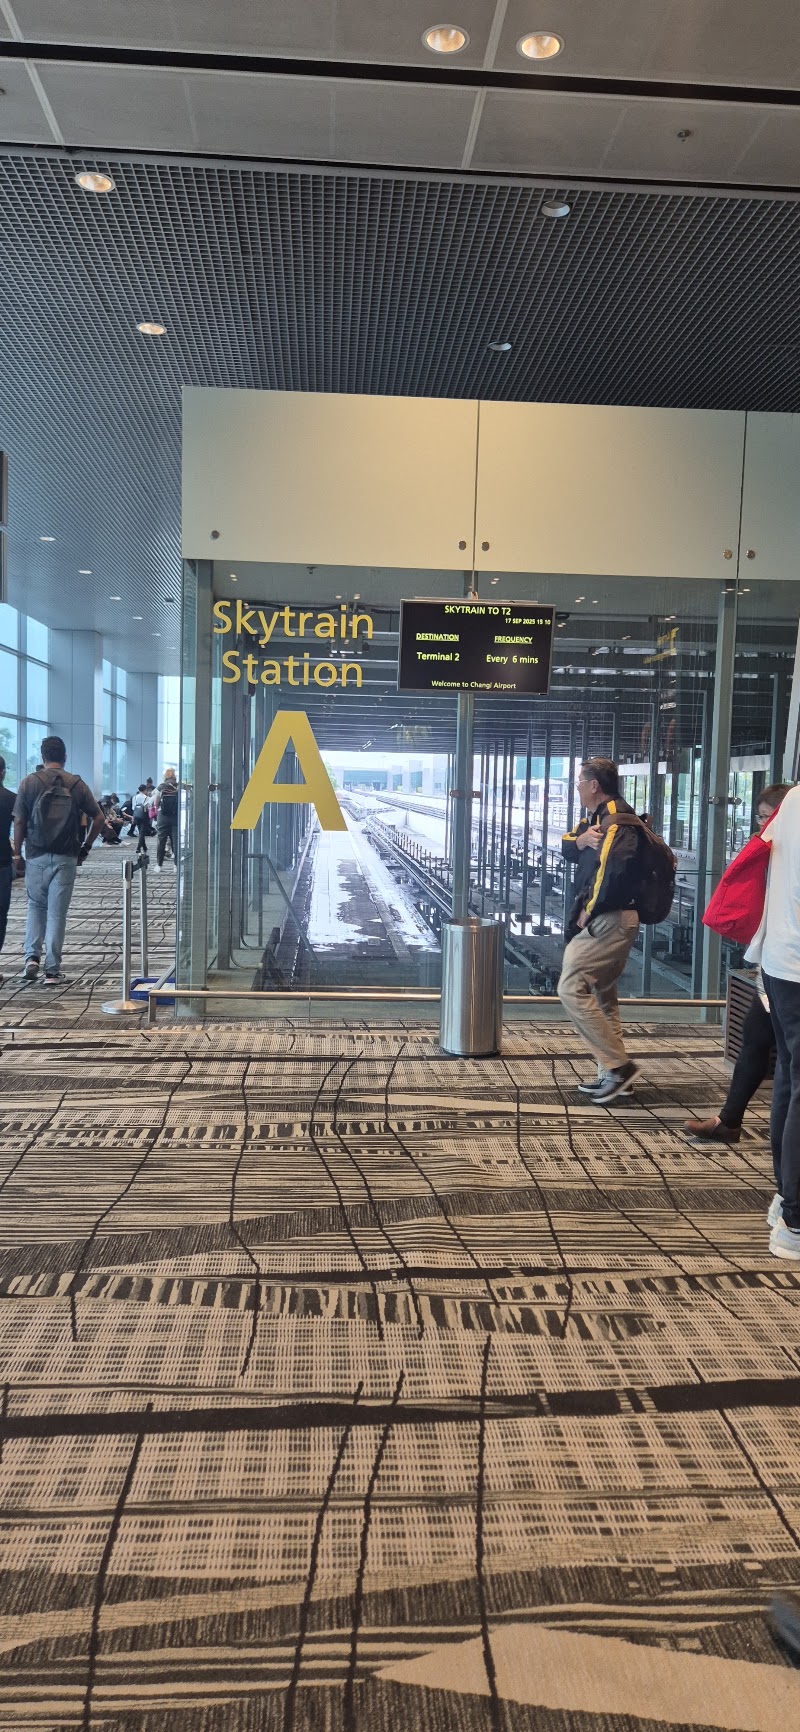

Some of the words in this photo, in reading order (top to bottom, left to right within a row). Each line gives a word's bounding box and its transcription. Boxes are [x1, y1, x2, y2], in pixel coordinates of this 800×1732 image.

[444, 605, 486, 615] SKYTRAIN
[487, 606, 500, 616] TO
[501, 607, 512, 616] T2
[213, 600, 373, 645] Skytrain
[415, 632, 460, 642] DESTINATION
[494, 635, 533, 644] FREQUENCY
[416, 651, 453, 661] Terminal
[454, 652, 460, 662] 2
[486, 654, 508, 665] Every
[512, 655, 518, 664] 6
[519, 655, 539, 664] mins
[222, 651, 363, 688] Station
[431, 680, 461, 688] Welcome
[461, 680, 469, 688] to
[469, 681, 493, 690] Changi
[493, 681, 517, 691] Airport
[229, 710, 349, 832] A
